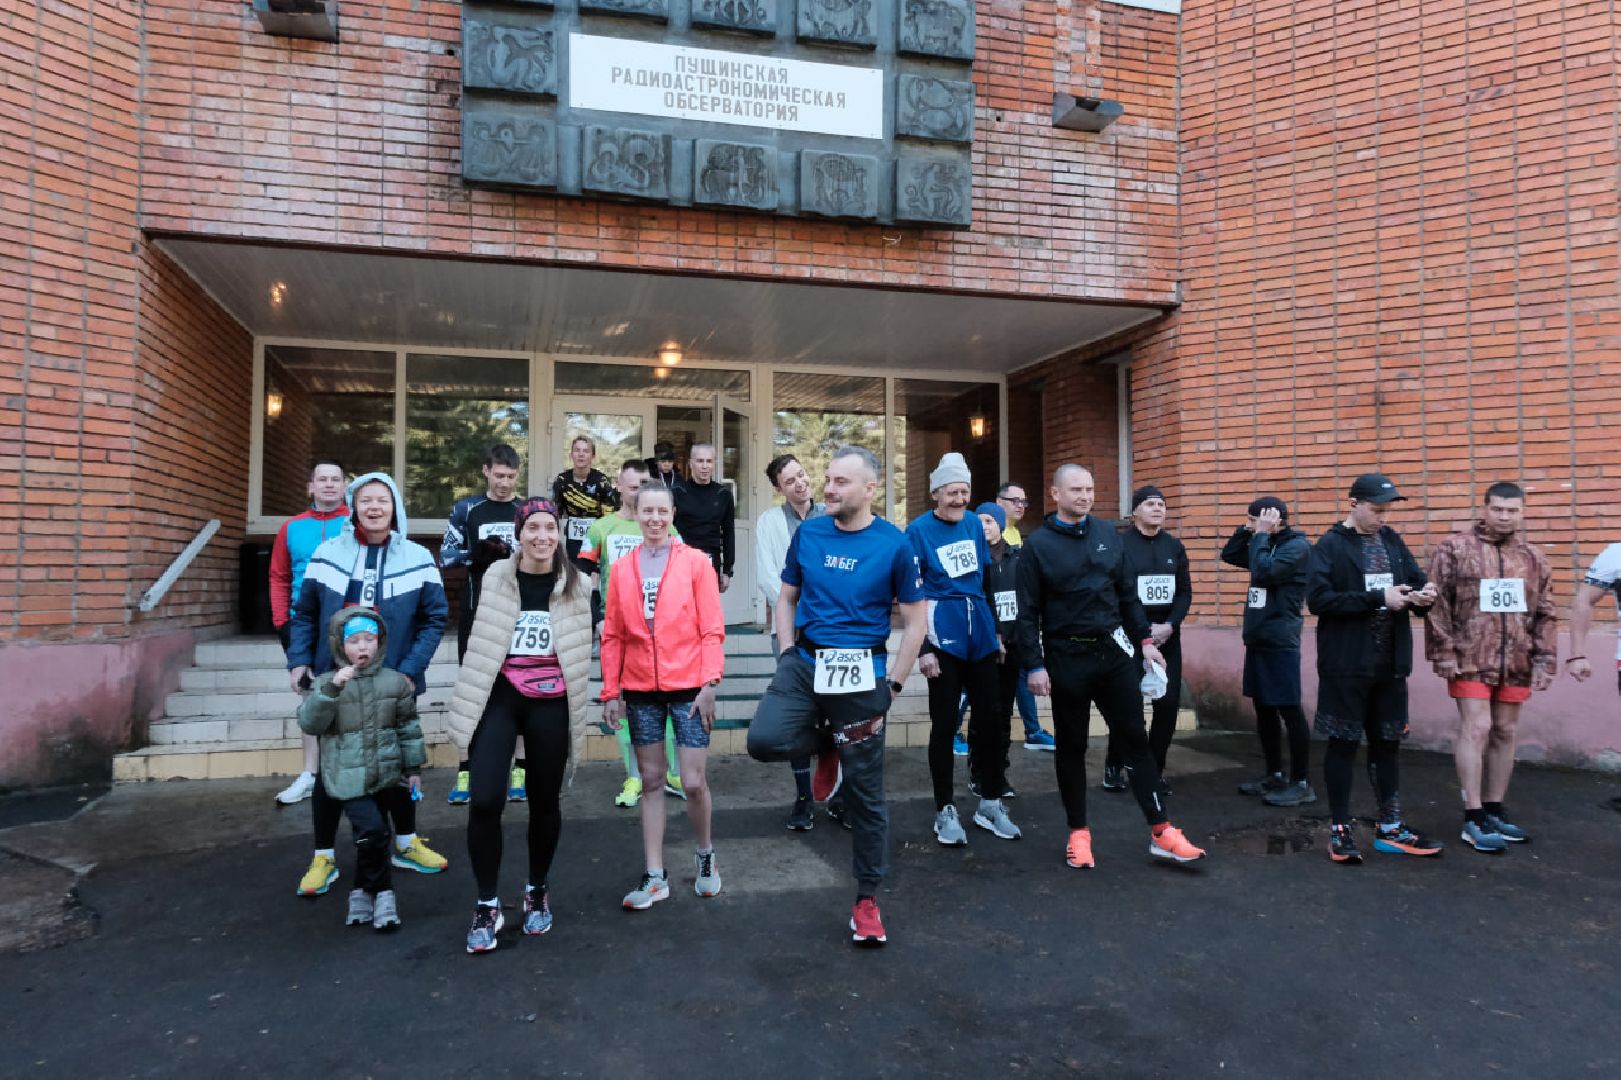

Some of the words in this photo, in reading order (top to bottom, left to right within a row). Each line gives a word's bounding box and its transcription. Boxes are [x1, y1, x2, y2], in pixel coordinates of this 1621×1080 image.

[675, 55, 788, 84] ПУЩИНСКАЯ
[611, 66, 846, 109] РАДИОАСТРОНОМИЧЕСКАЯ
[663, 91, 798, 122] ОБСЕРВАТОРИЯ
[1146, 586, 1169, 600] 805
[514, 626, 551, 650] 759
[837, 652, 862, 663] asics
[825, 664, 862, 688] 778
